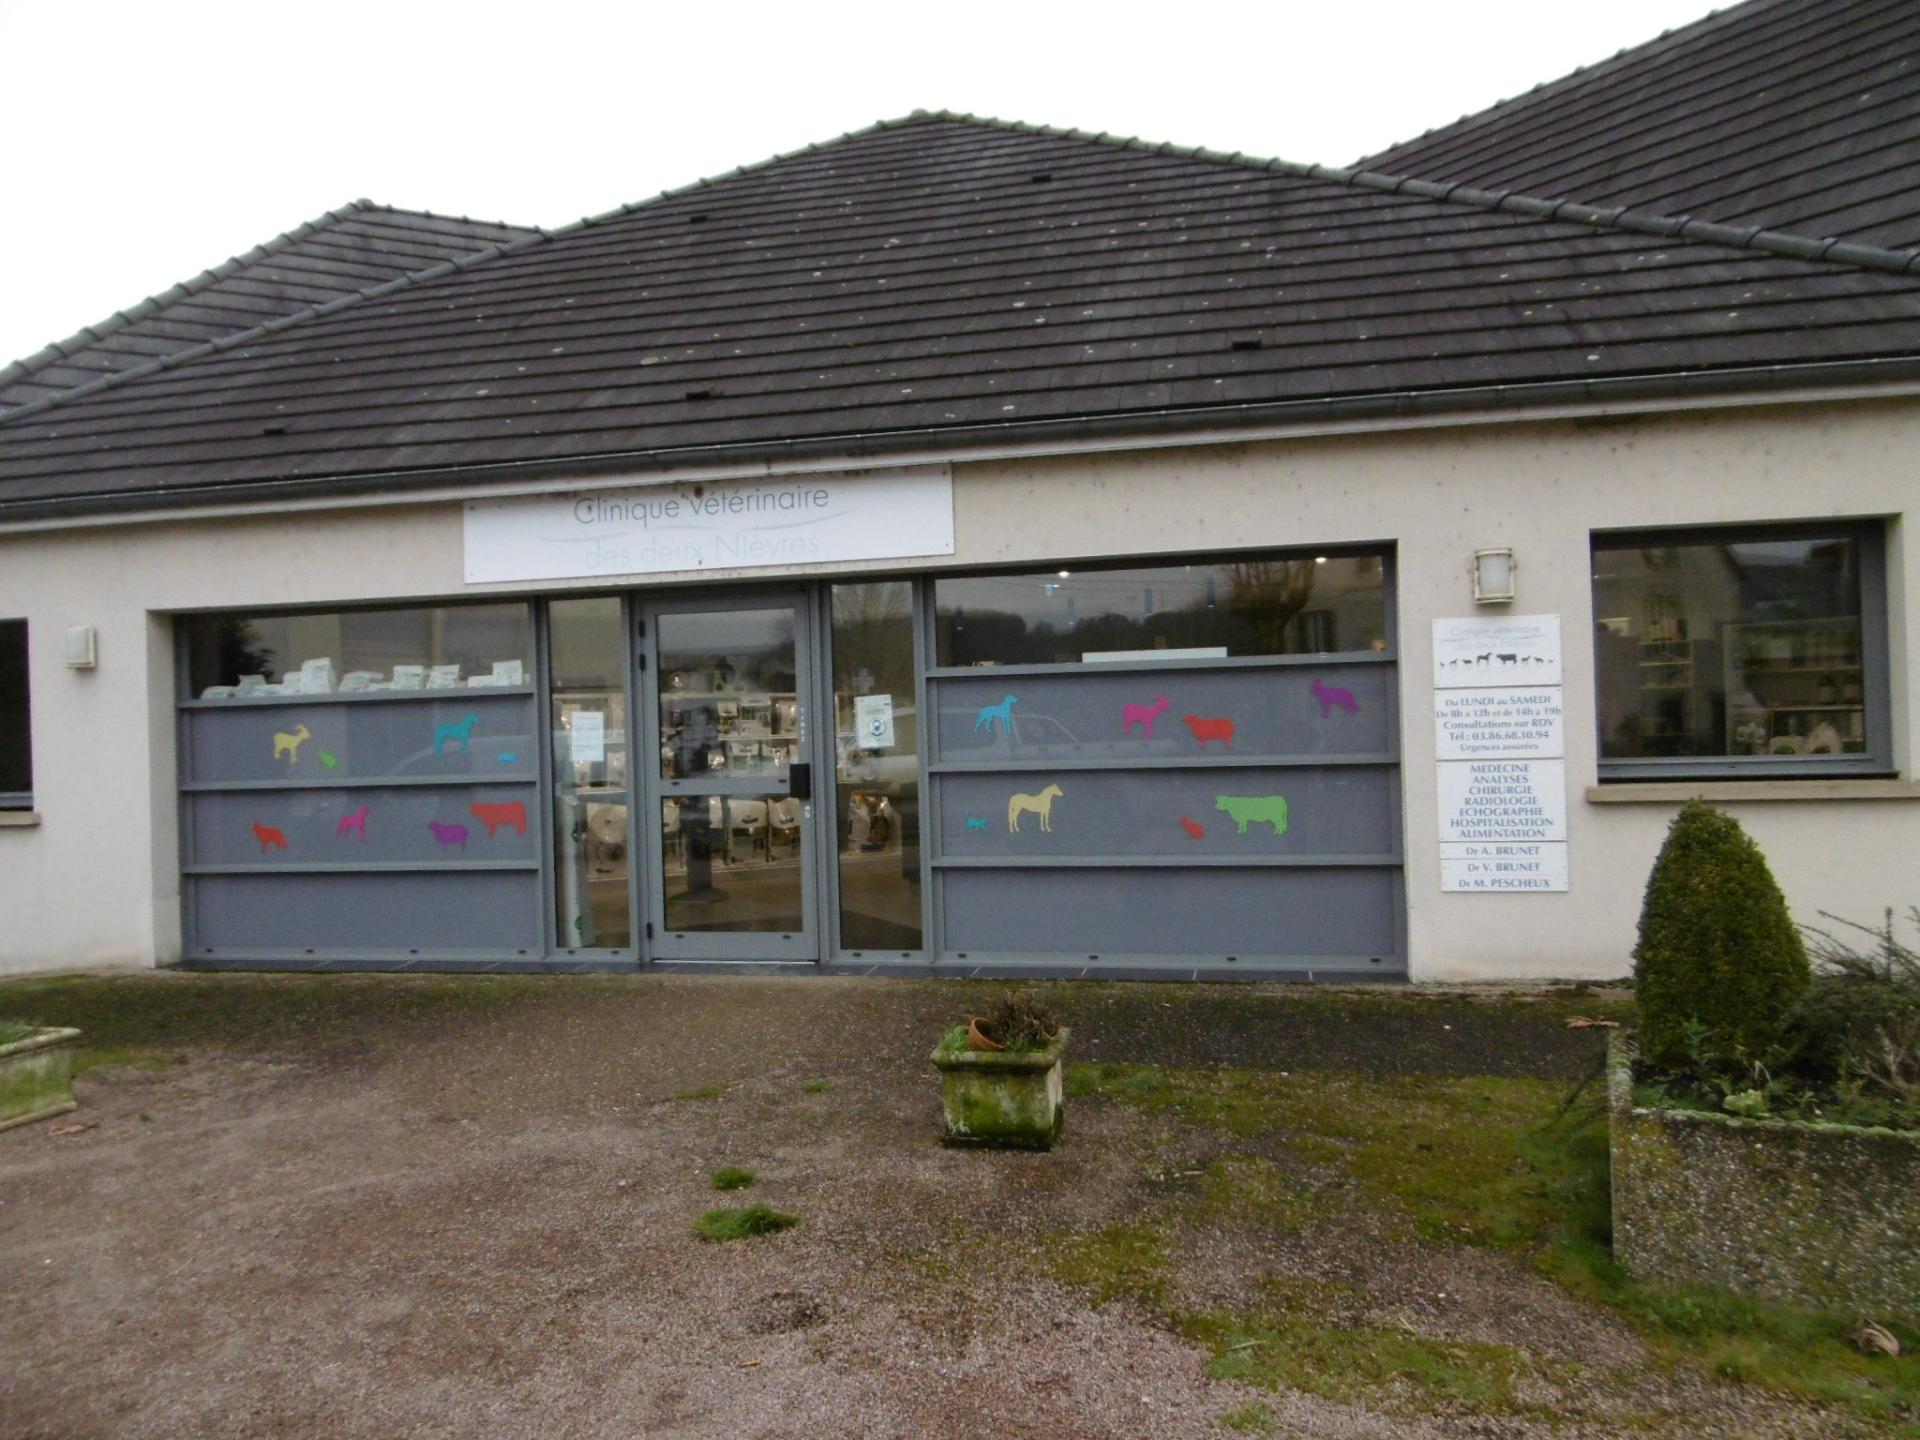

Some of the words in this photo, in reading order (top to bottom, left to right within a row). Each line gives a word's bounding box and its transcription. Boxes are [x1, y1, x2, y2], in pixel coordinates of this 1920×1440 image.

[574, 495, 680, 528] Clinique
[585, 538, 629, 569] des
[640, 537, 704, 563] deux
[715, 534, 820, 559] Nièvres
[1461, 697, 1494, 705] LUNDI
[1510, 695, 1551, 704] SAMEDI
[1473, 708, 1490, 717] 12h
[1516, 707, 1533, 716] 14h
[1544, 706, 1562, 715] 19h
[1443, 719, 1511, 729] Consultations
[1532, 718, 1554, 727] RDV
[1460, 743, 1500, 752] Urgences
[1472, 775, 1528, 784] ANALYSES
[1469, 786, 1533, 795] CHIRURGIE
[1465, 796, 1538, 806] RADIOLOGIE
[1459, 807, 1544, 817] ECHOGRAPHIE
[1451, 817, 1554, 828] HOSPITALISATION
[1459, 829, 1545, 838] ALIMENTATION
[1466, 847, 1478, 856] Dr
[1481, 847, 1492, 855] A.
[1496, 846, 1540, 855] BRUNET
[1468, 864, 1480, 872] Dr
[1483, 863, 1493, 871] V.
[1496, 863, 1541, 871] BRUNET
[1459, 880, 1471, 888] Dr
[1474, 880, 1488, 888] M.
[1491, 879, 1550, 888] PESCHEUX
